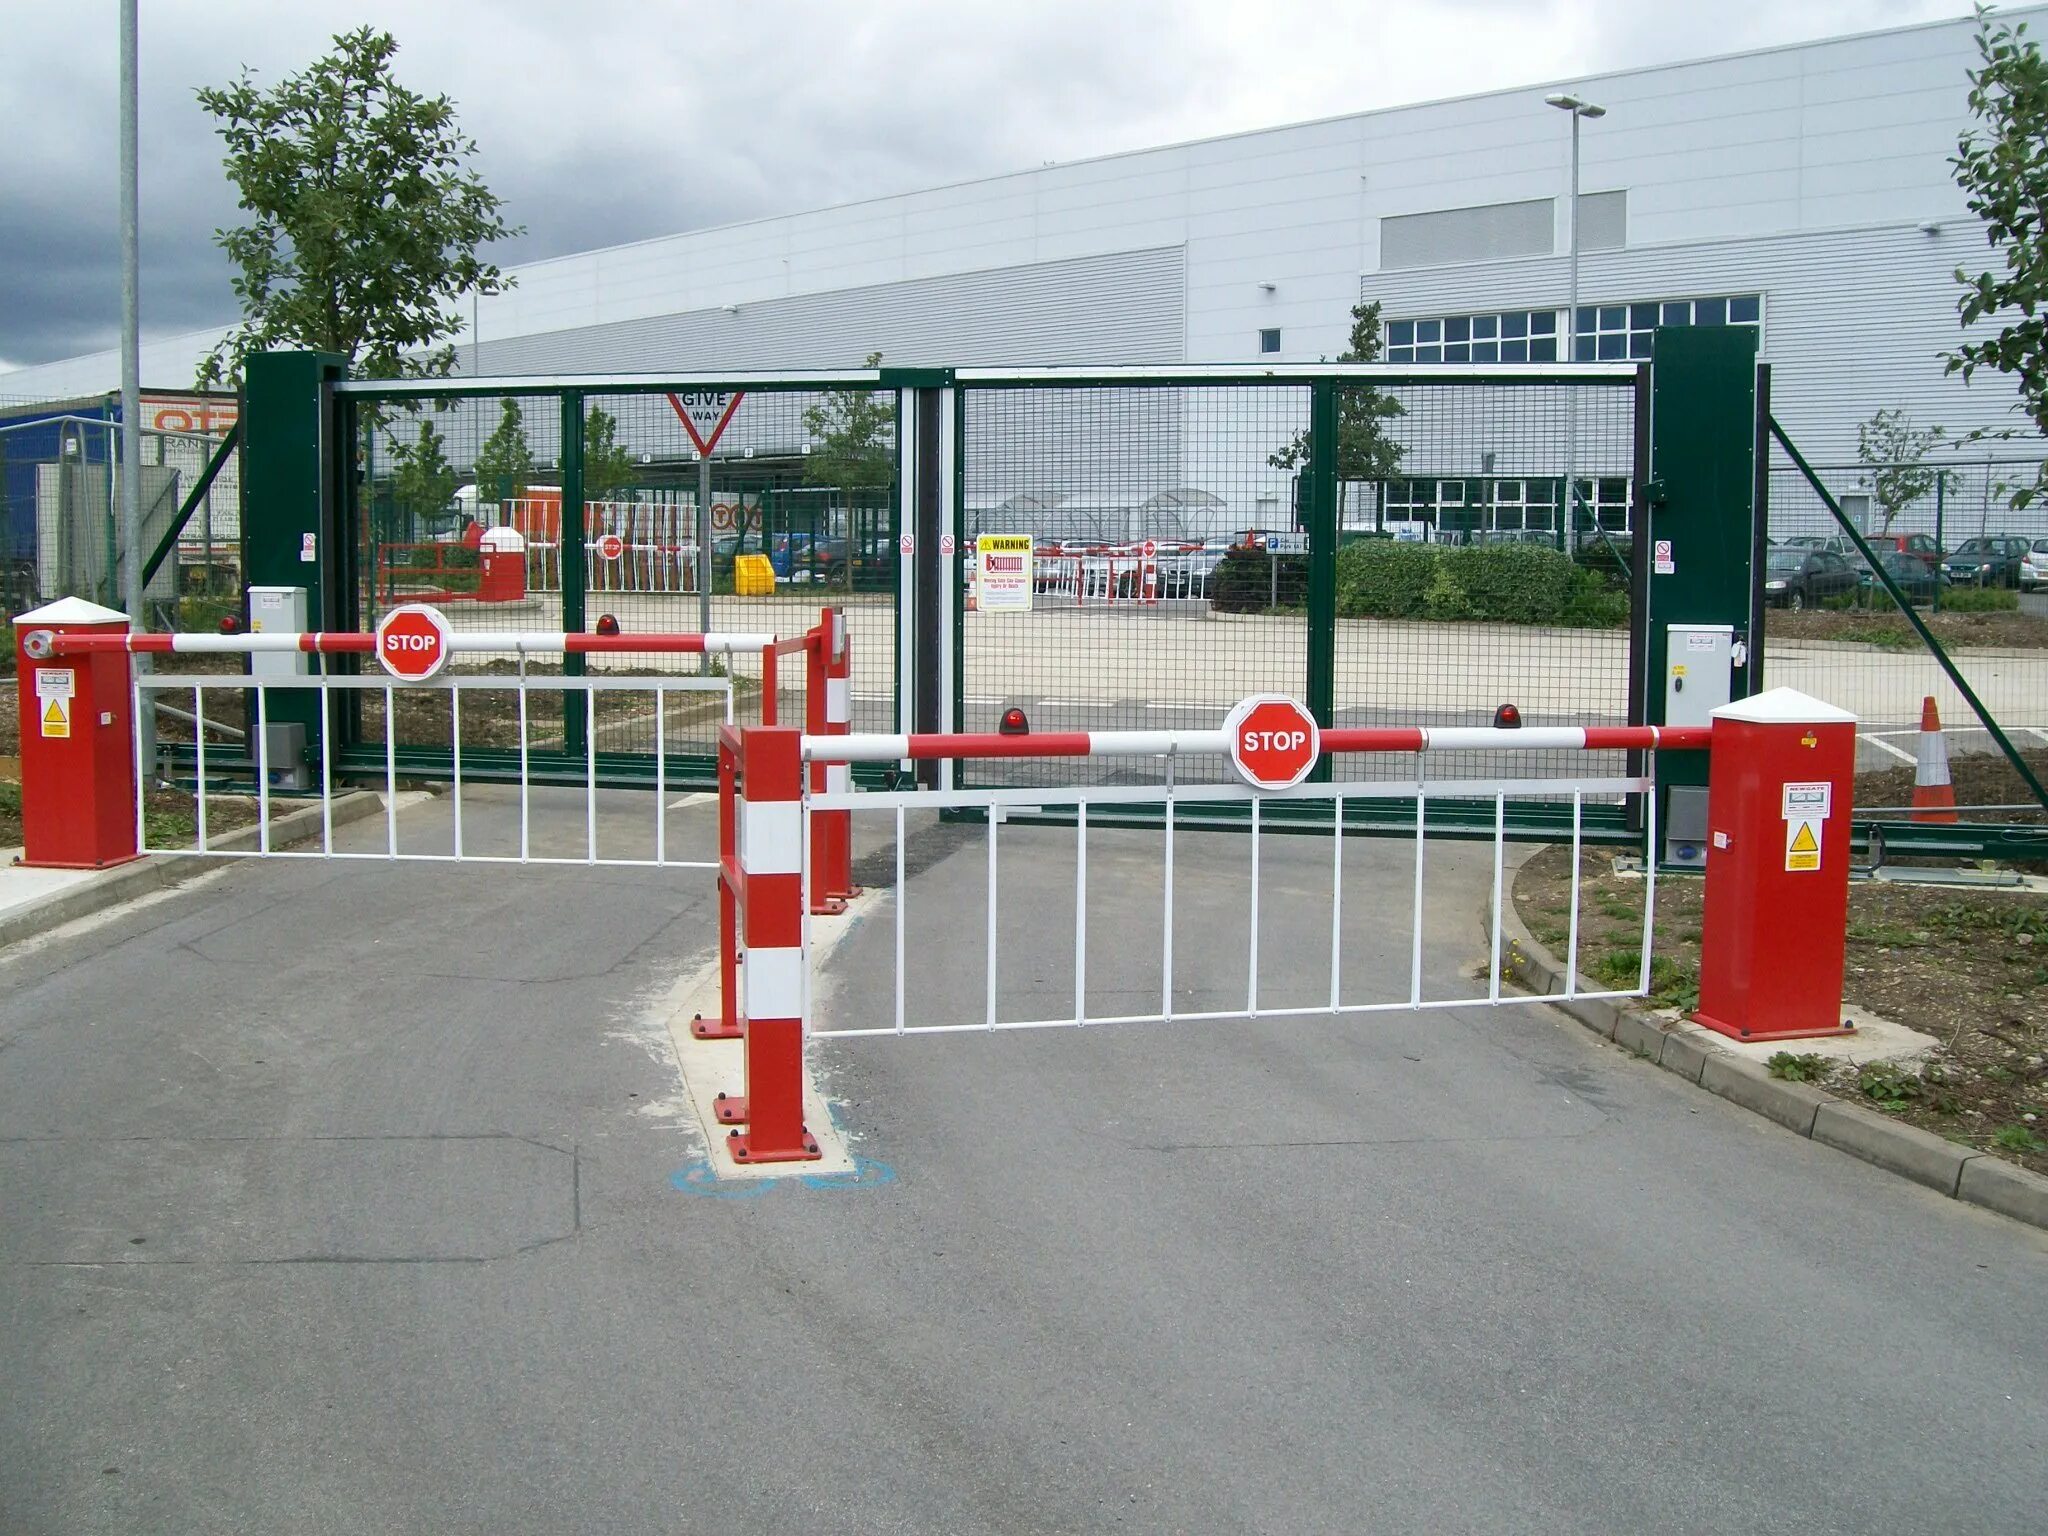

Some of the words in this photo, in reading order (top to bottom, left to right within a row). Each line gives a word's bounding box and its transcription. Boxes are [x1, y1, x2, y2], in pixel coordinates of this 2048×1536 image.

[682, 392, 727, 406] GIVE
[692, 411, 720, 421] WAY
[992, 540, 1030, 550] WARNING
[386, 634, 436, 651] STOP
[1244, 731, 1306, 751] STOP
